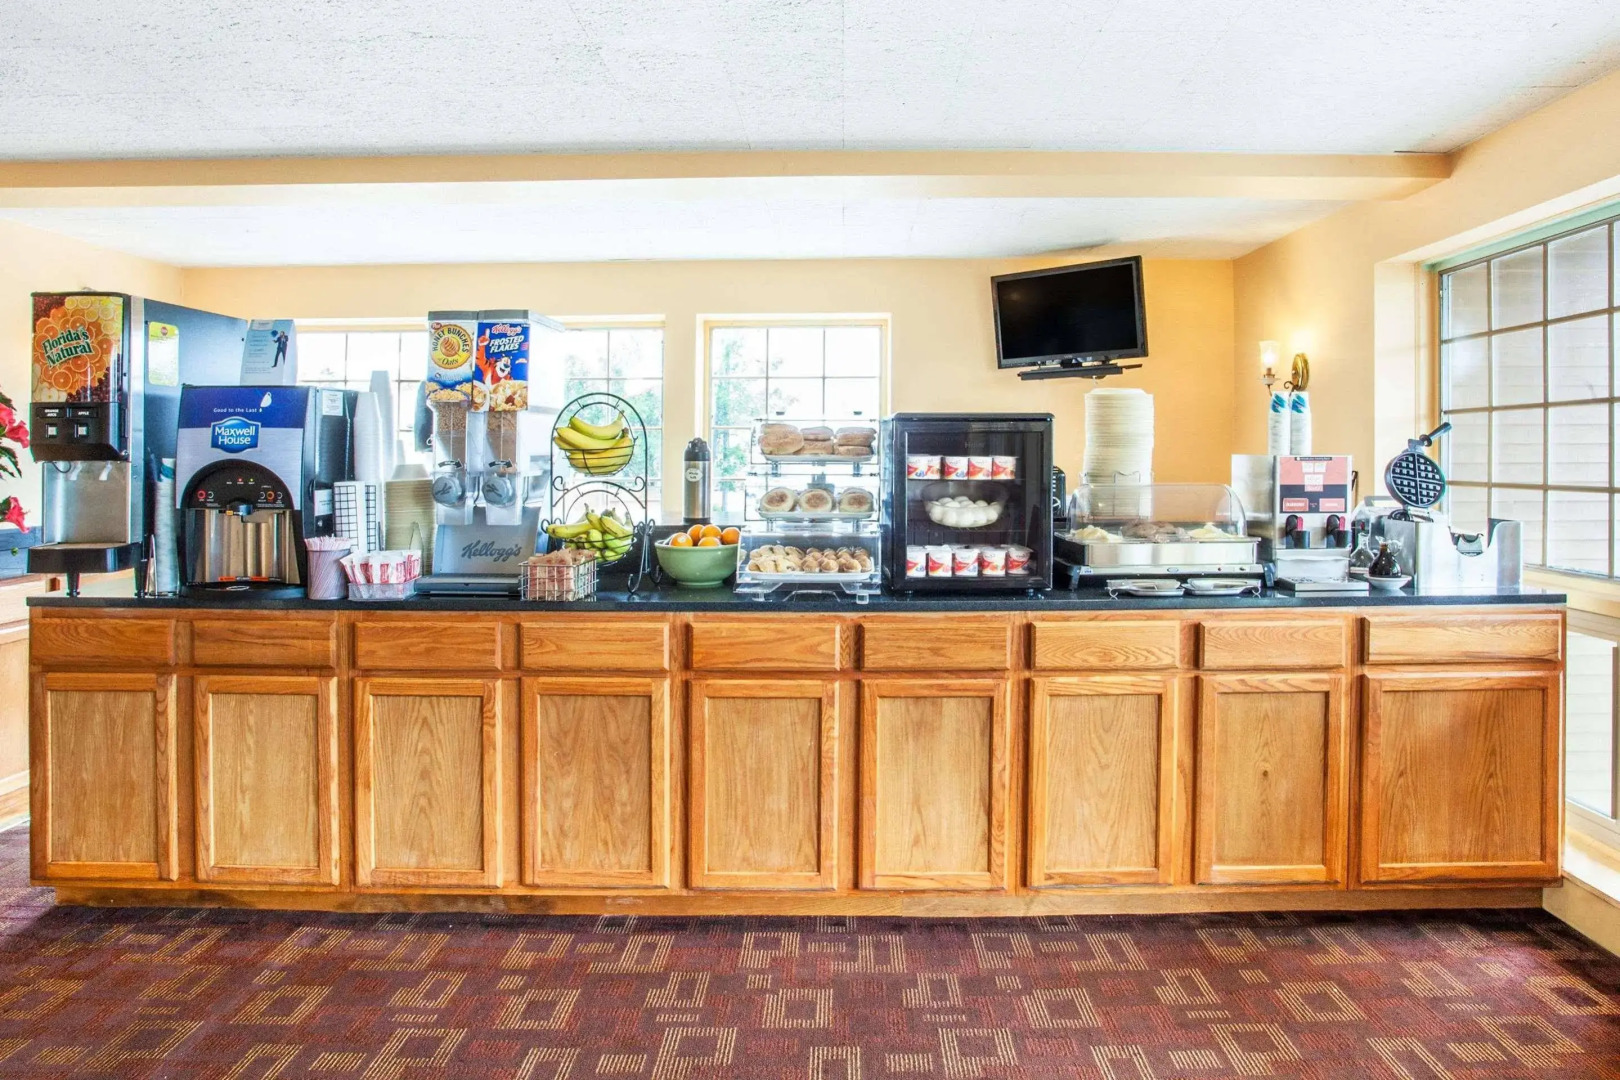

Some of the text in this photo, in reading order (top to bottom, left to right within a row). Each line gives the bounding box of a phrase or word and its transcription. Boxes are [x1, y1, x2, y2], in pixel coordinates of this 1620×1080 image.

[42, 327, 90, 354] Florida's
[432, 327, 470, 353] HONEY BUNCHES
[489, 335, 525, 347] FROSTED
[46, 341, 93, 365] Natural
[489, 343, 519, 353] FLAKES
[441, 358, 459, 366] Oats
[215, 425, 256, 436] Maxwell
[218, 435, 251, 445] House
[461, 539, 523, 562] Kellogg's
